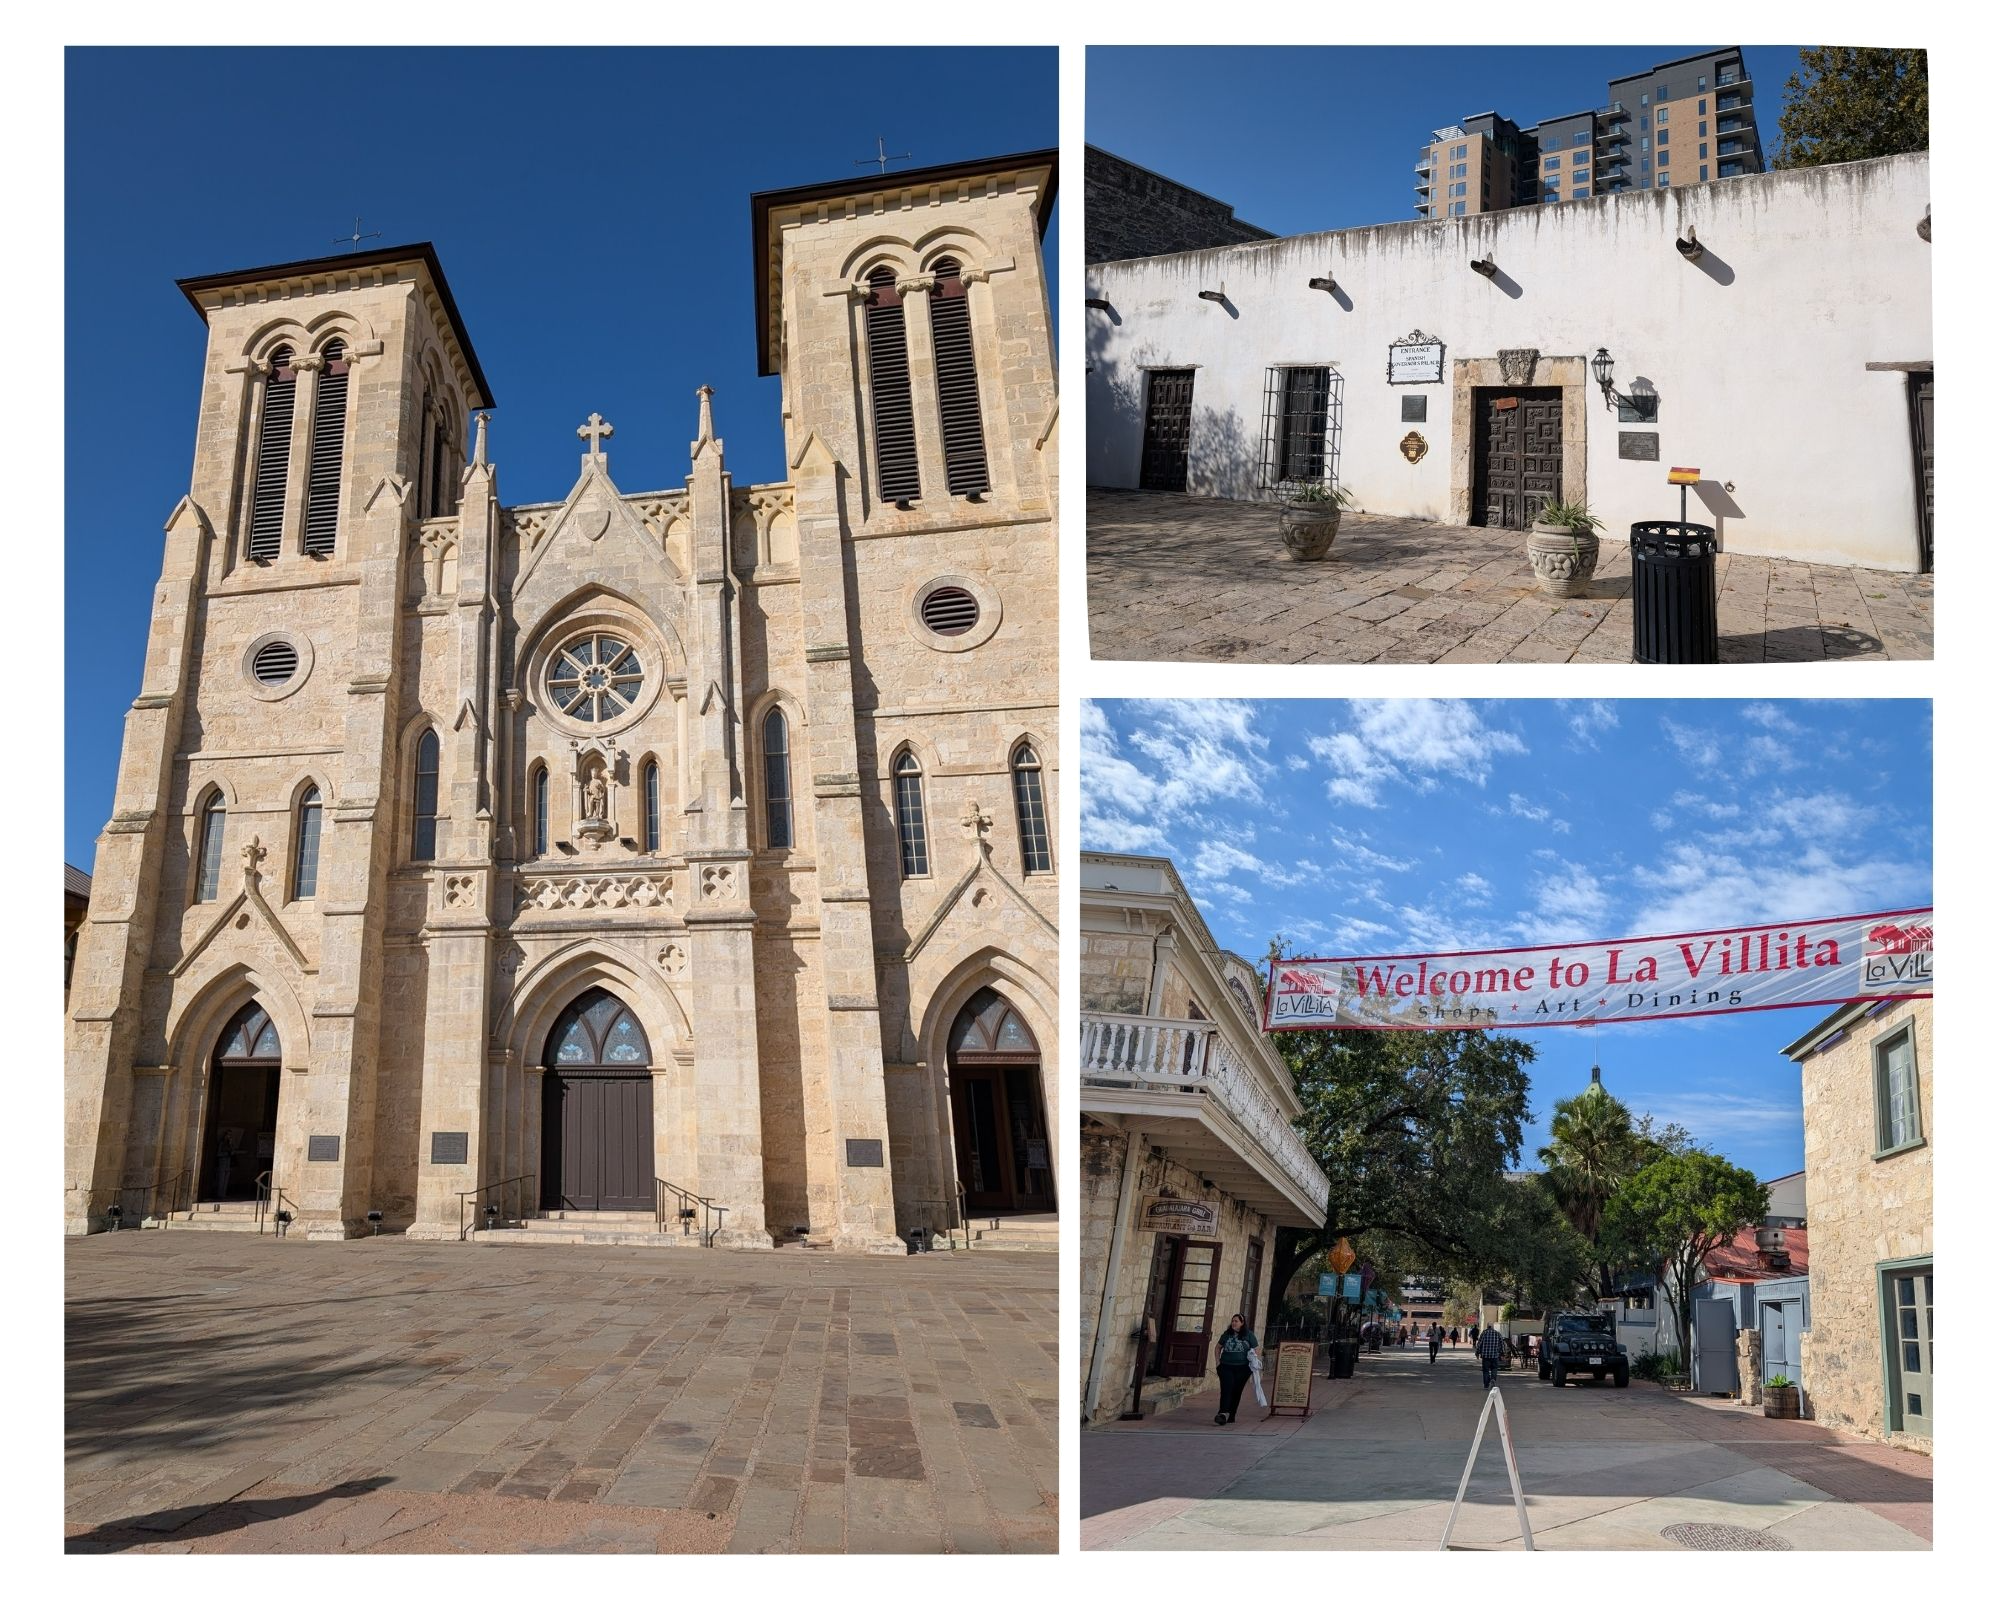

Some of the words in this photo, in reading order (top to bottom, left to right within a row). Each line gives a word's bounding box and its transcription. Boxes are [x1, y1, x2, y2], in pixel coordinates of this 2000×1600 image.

[1355, 961, 1535, 999] Welcome
[1548, 957, 1590, 989] to
[1606, 949, 1659, 985] La
[1676, 932, 1842, 978] Villita
[1865, 957, 1886, 982] La
[1275, 996, 1289, 1016] La
[1417, 1003, 1498, 1019] Shops
[1535, 999, 1582, 1014] Art
[1627, 988, 1742, 1008] Dining
[1142, 1221, 1187, 1231] RESTAURANT
